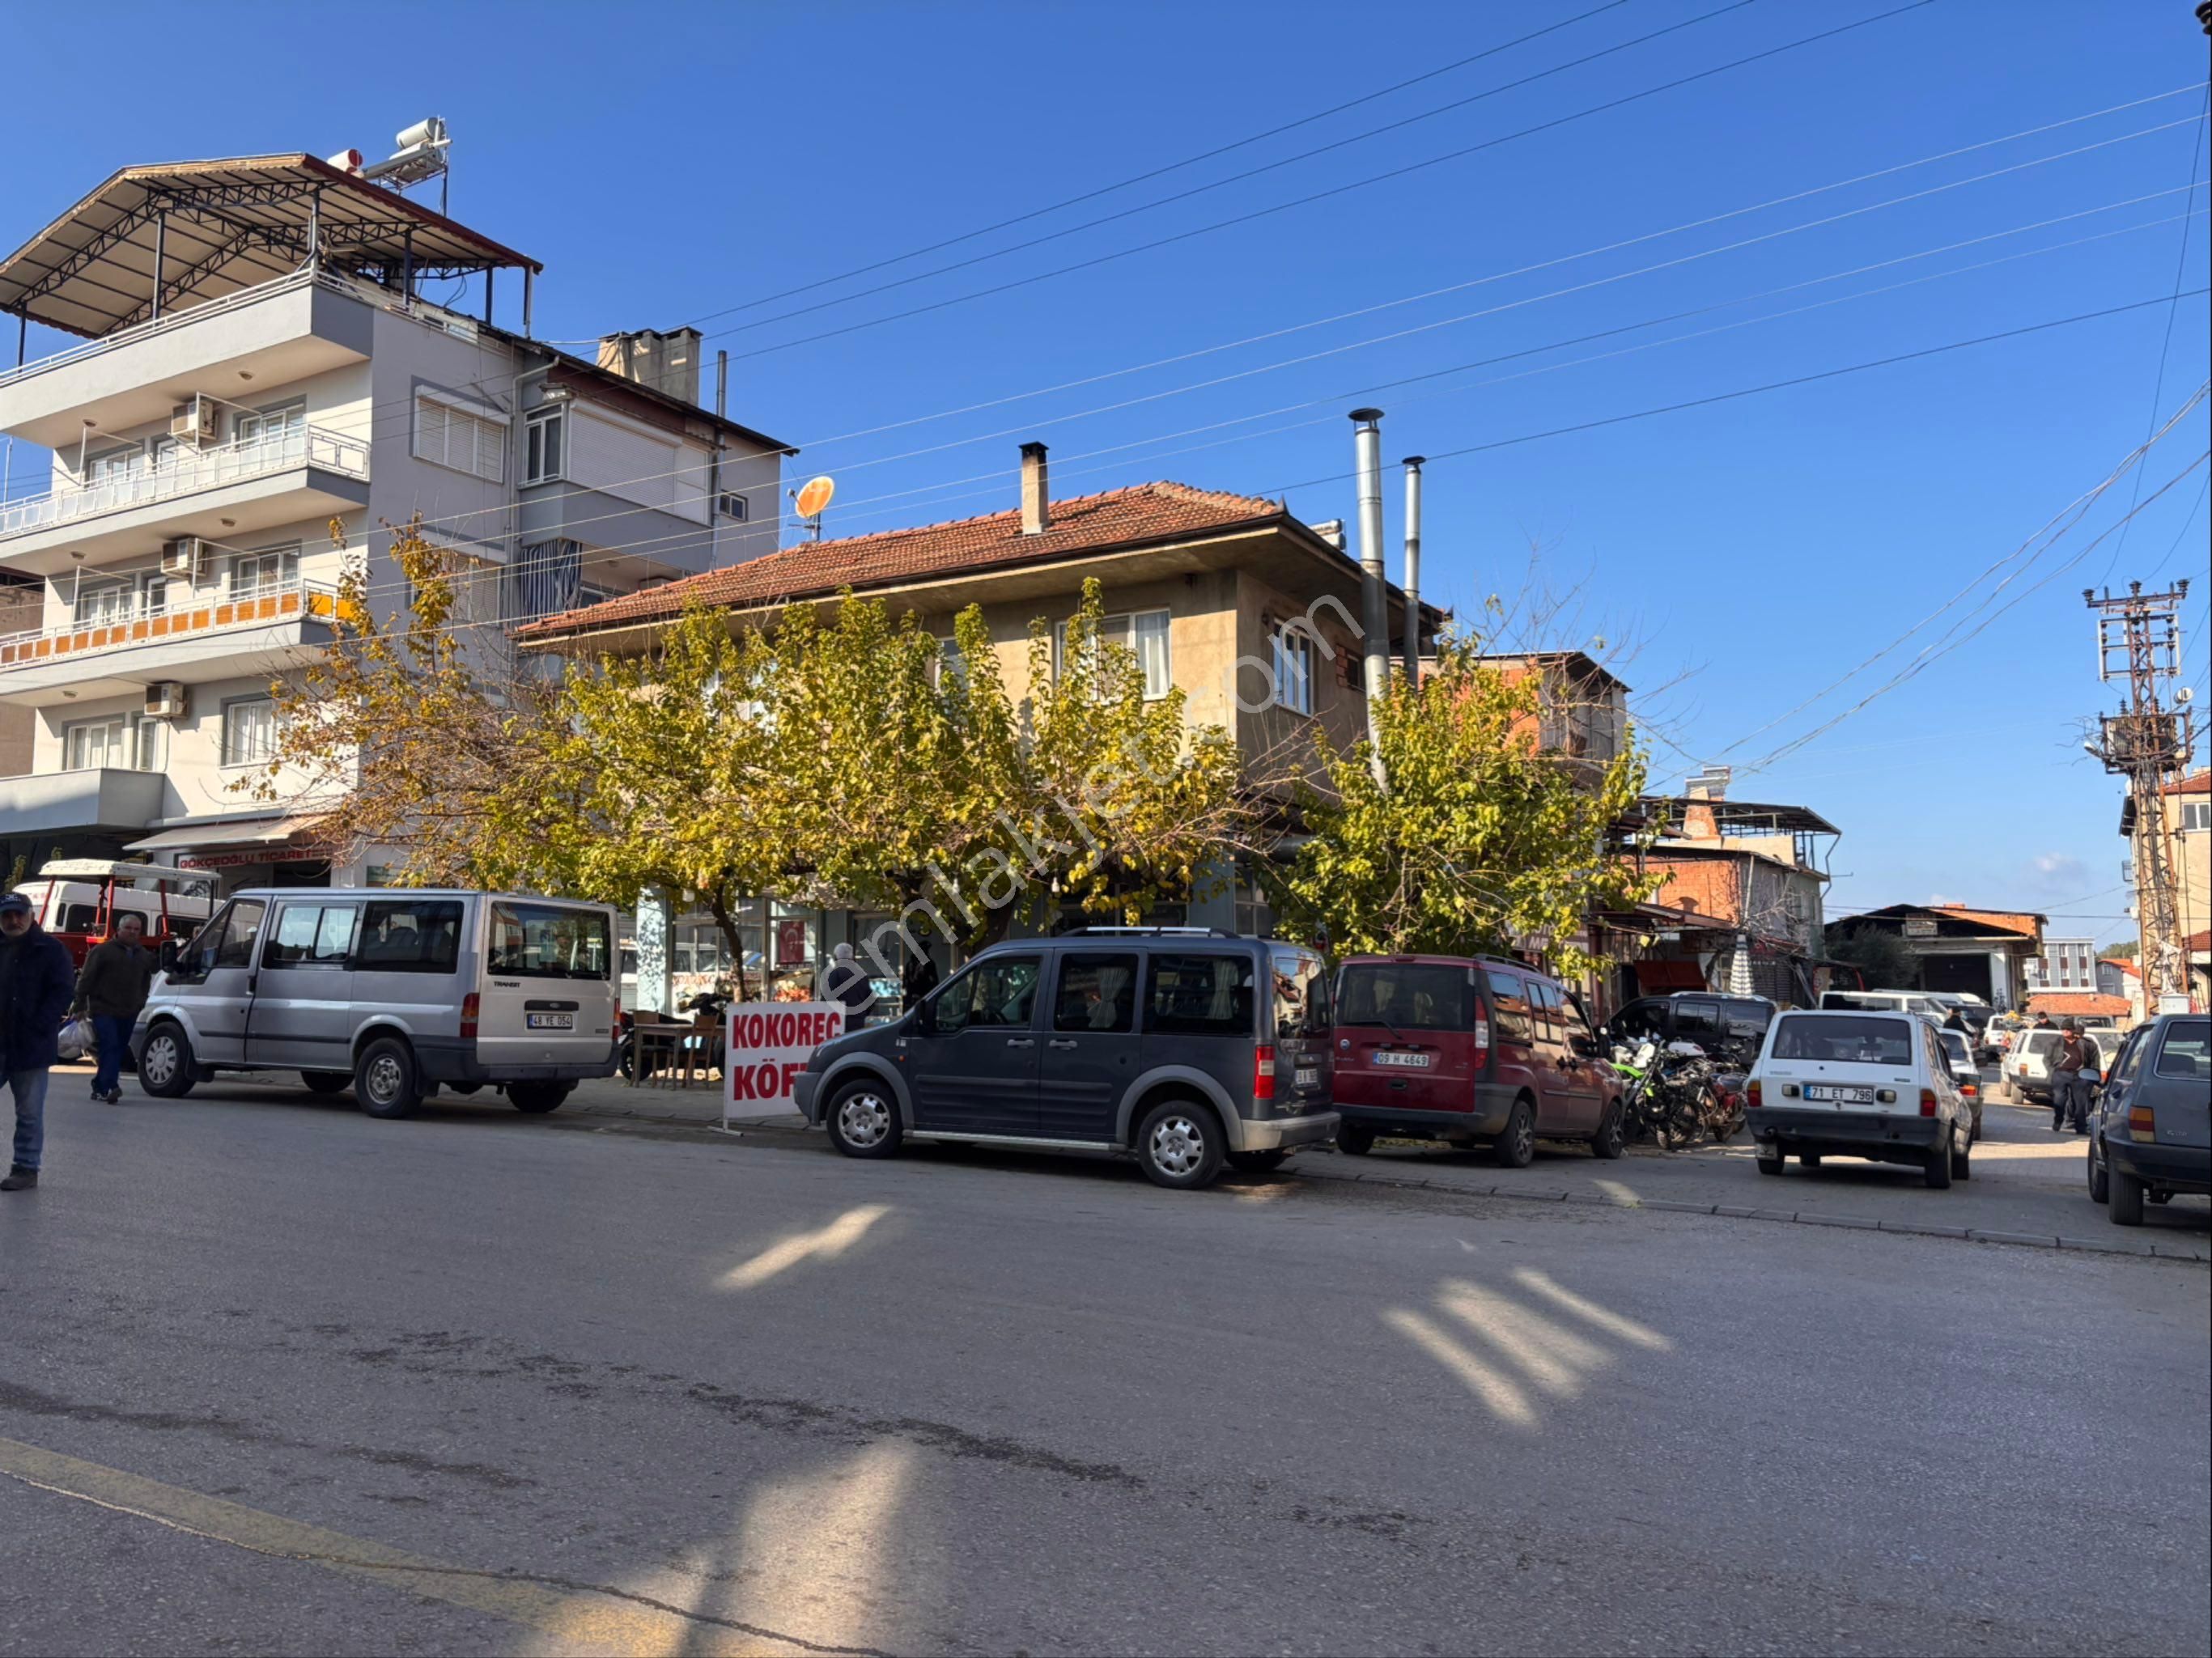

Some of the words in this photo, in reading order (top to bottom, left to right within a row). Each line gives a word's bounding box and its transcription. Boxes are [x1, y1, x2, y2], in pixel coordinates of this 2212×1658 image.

[533, 1015, 542, 1025] 48
[546, 1015, 554, 1026] YE
[557, 1015, 571, 1026] 054
[1378, 1054, 1389, 1063] 09
[1393, 1055, 1400, 1064] H
[1404, 1055, 1428, 1066] 4649
[733, 1058, 808, 1100] KÖF
[1812, 1088, 1824, 1098] 71
[1832, 1088, 1845, 1099] ET
[1853, 1089, 1872, 1100] 796
